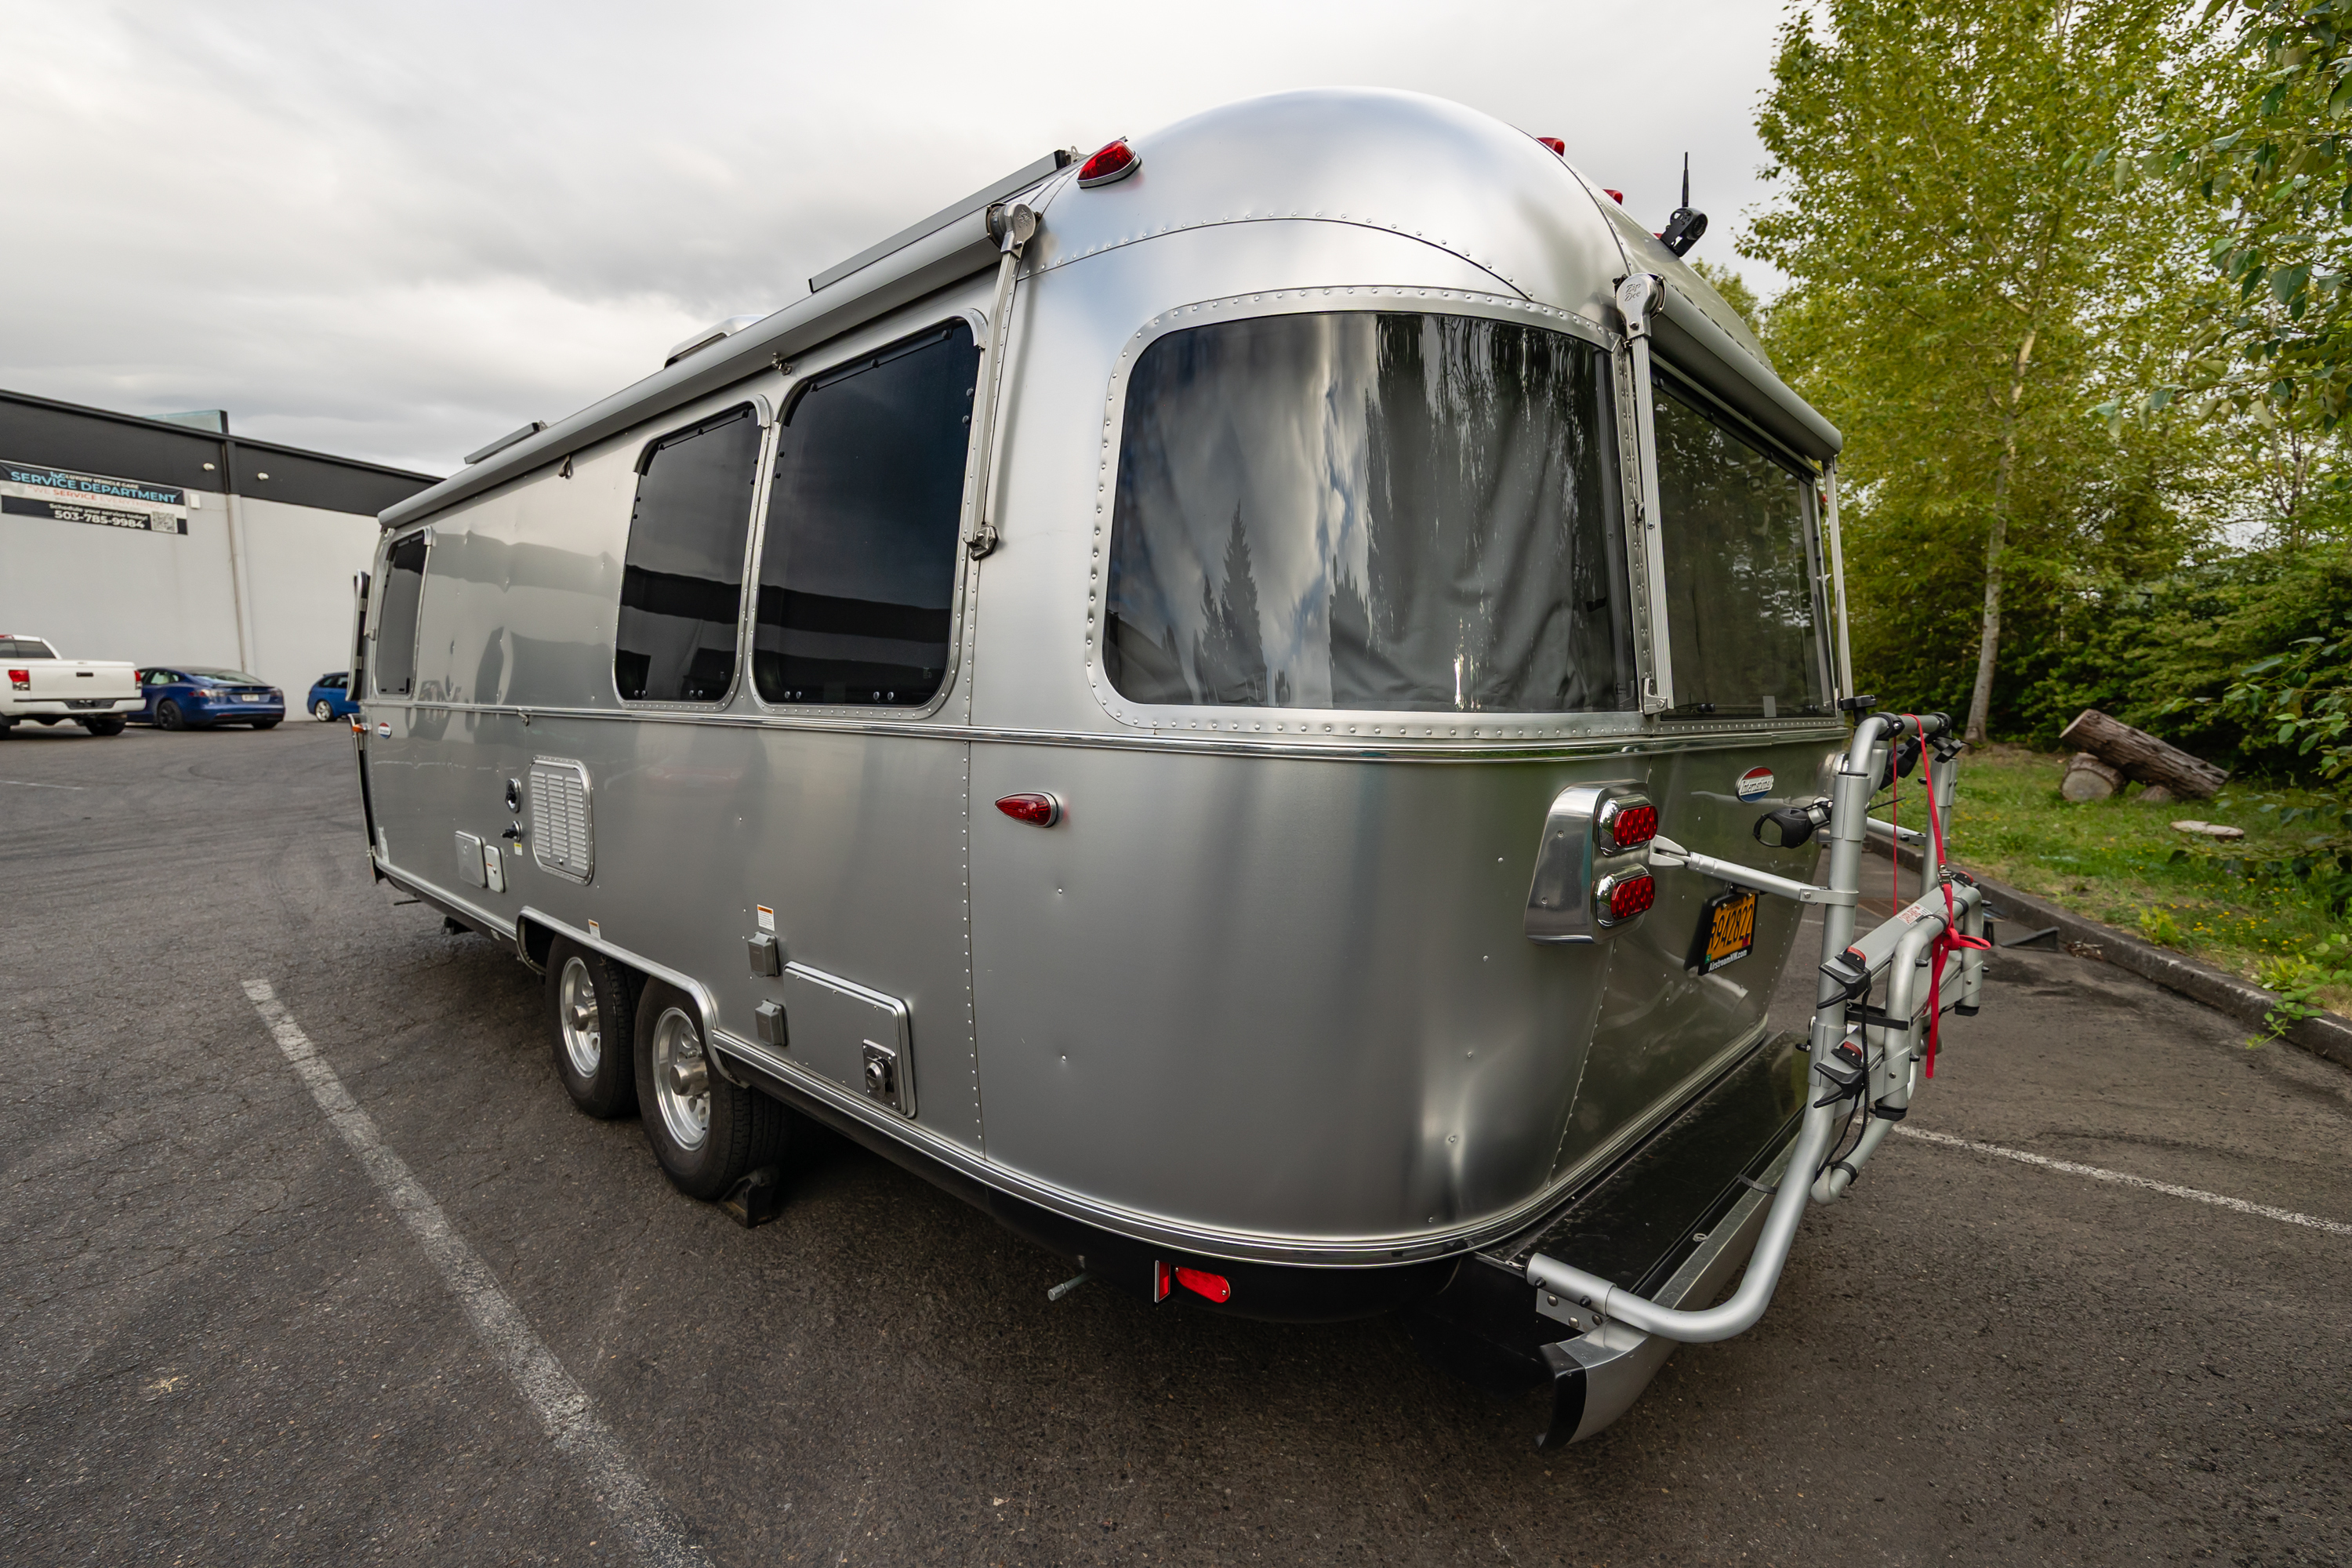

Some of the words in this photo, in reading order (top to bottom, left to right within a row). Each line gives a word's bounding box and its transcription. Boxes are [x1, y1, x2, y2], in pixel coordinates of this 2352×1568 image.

[1625, 283, 1641, 293] Zip
[1624, 292, 1641, 302] Dee
[10, 471, 77, 489] SERVICE
[81, 481, 176, 503] DEPARTMENT
[53, 488, 96, 501] SERVICE
[49, 503, 84, 513] Schedule
[54, 510, 145, 528] 503-785-9984
[1710, 903, 1753, 951] R942822
[1708, 949, 1748, 972] AirstreamNW.com
